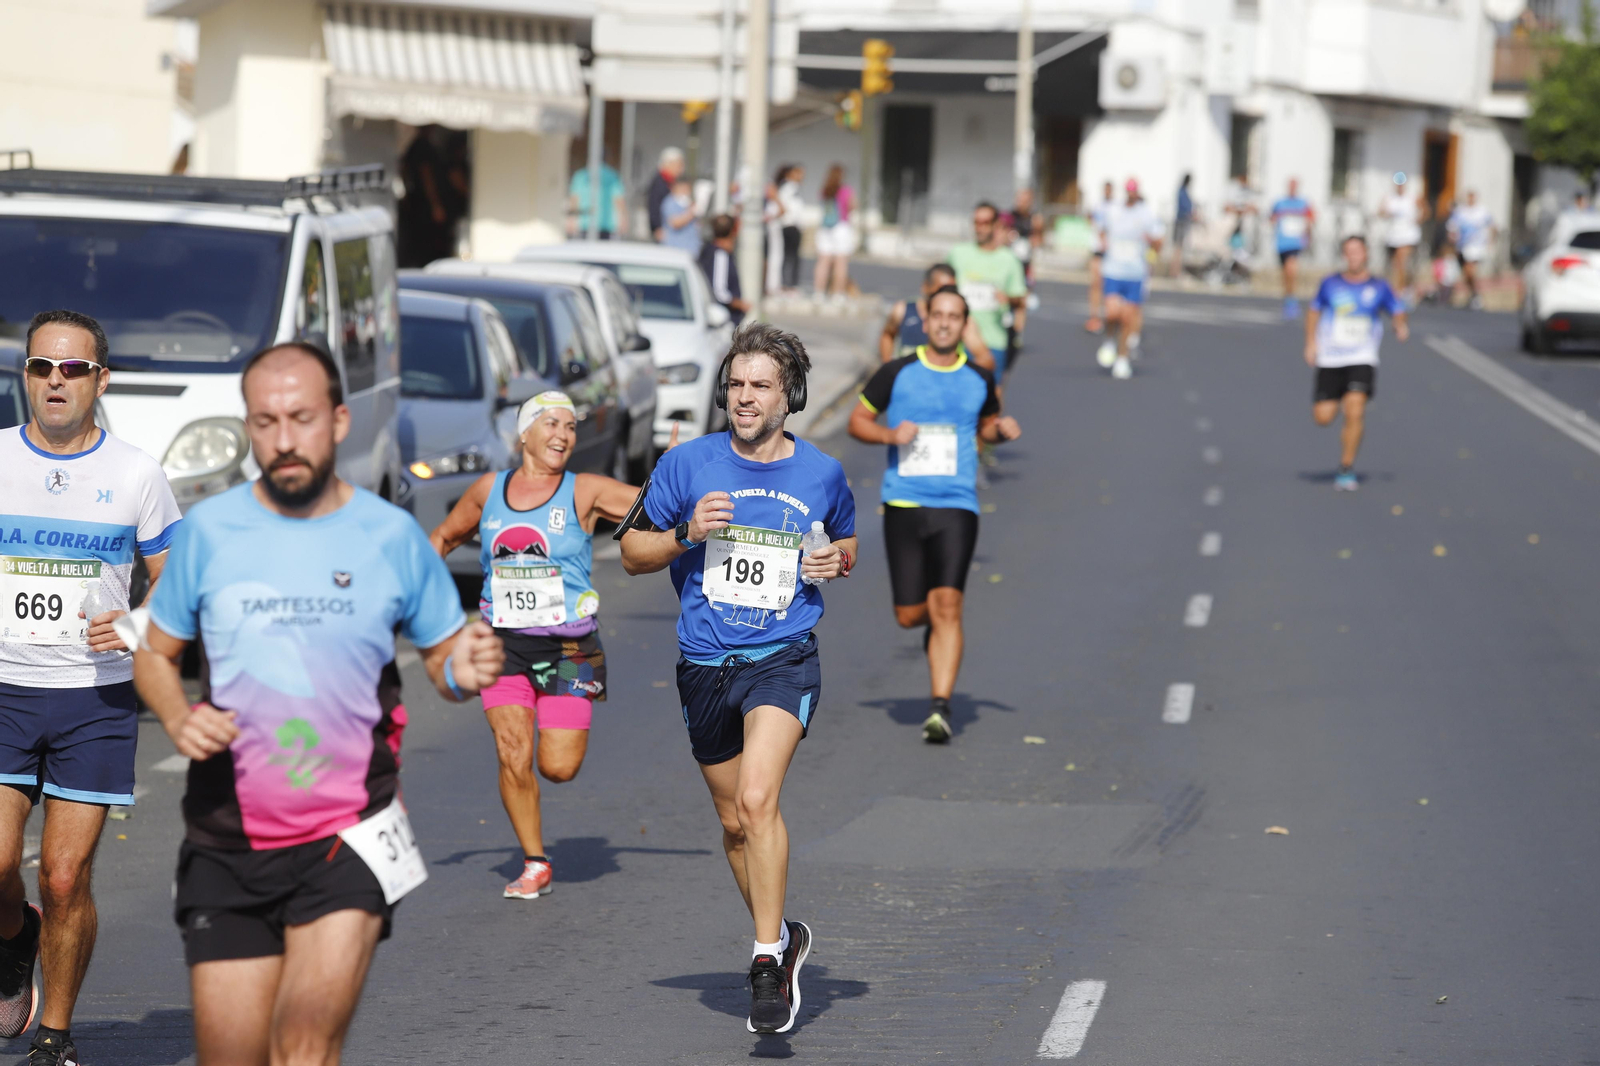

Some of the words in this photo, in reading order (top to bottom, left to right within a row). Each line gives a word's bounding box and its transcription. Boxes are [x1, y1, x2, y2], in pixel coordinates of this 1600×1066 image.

[730, 488, 767, 499] VUELTA
[768, 489, 776, 499] A
[777, 491, 810, 516] HUELVA
[34, 529, 126, 552] CORRALES
[726, 542, 759, 552] CARMELO
[727, 529, 756, 543] VUELTA
[757, 532, 763, 544] A
[765, 533, 794, 548] HUELVA
[5, 561, 15, 573] 34
[17, 561, 50, 575] VUELTA
[52, 563, 59, 575] A
[61, 564, 94, 576] HUELVA
[722, 556, 765, 586] 198
[14, 592, 63, 621] 669
[240, 598, 355, 616] TARTESSOS
[504, 591, 537, 611] 159
[271, 617, 323, 627] HUELVA
